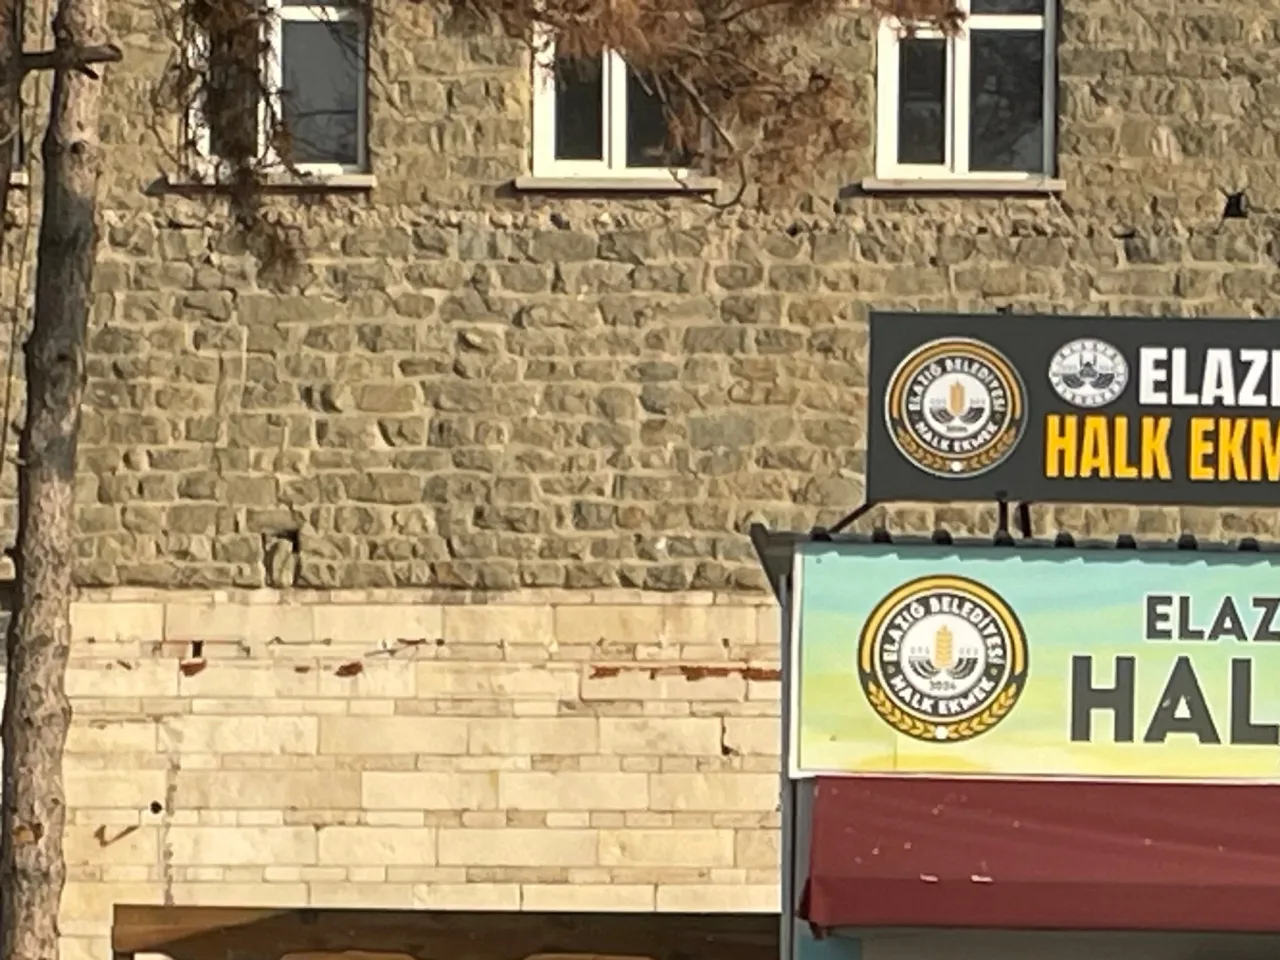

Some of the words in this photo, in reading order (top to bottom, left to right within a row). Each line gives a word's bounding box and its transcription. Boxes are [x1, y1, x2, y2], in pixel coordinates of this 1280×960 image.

[915, 421, 951, 451] HALK
[953, 421, 999, 452] EKMEK
[1045, 414, 1172, 480] HALK
[890, 674, 935, 713] HALK
[937, 676, 996, 715] EKMEK
